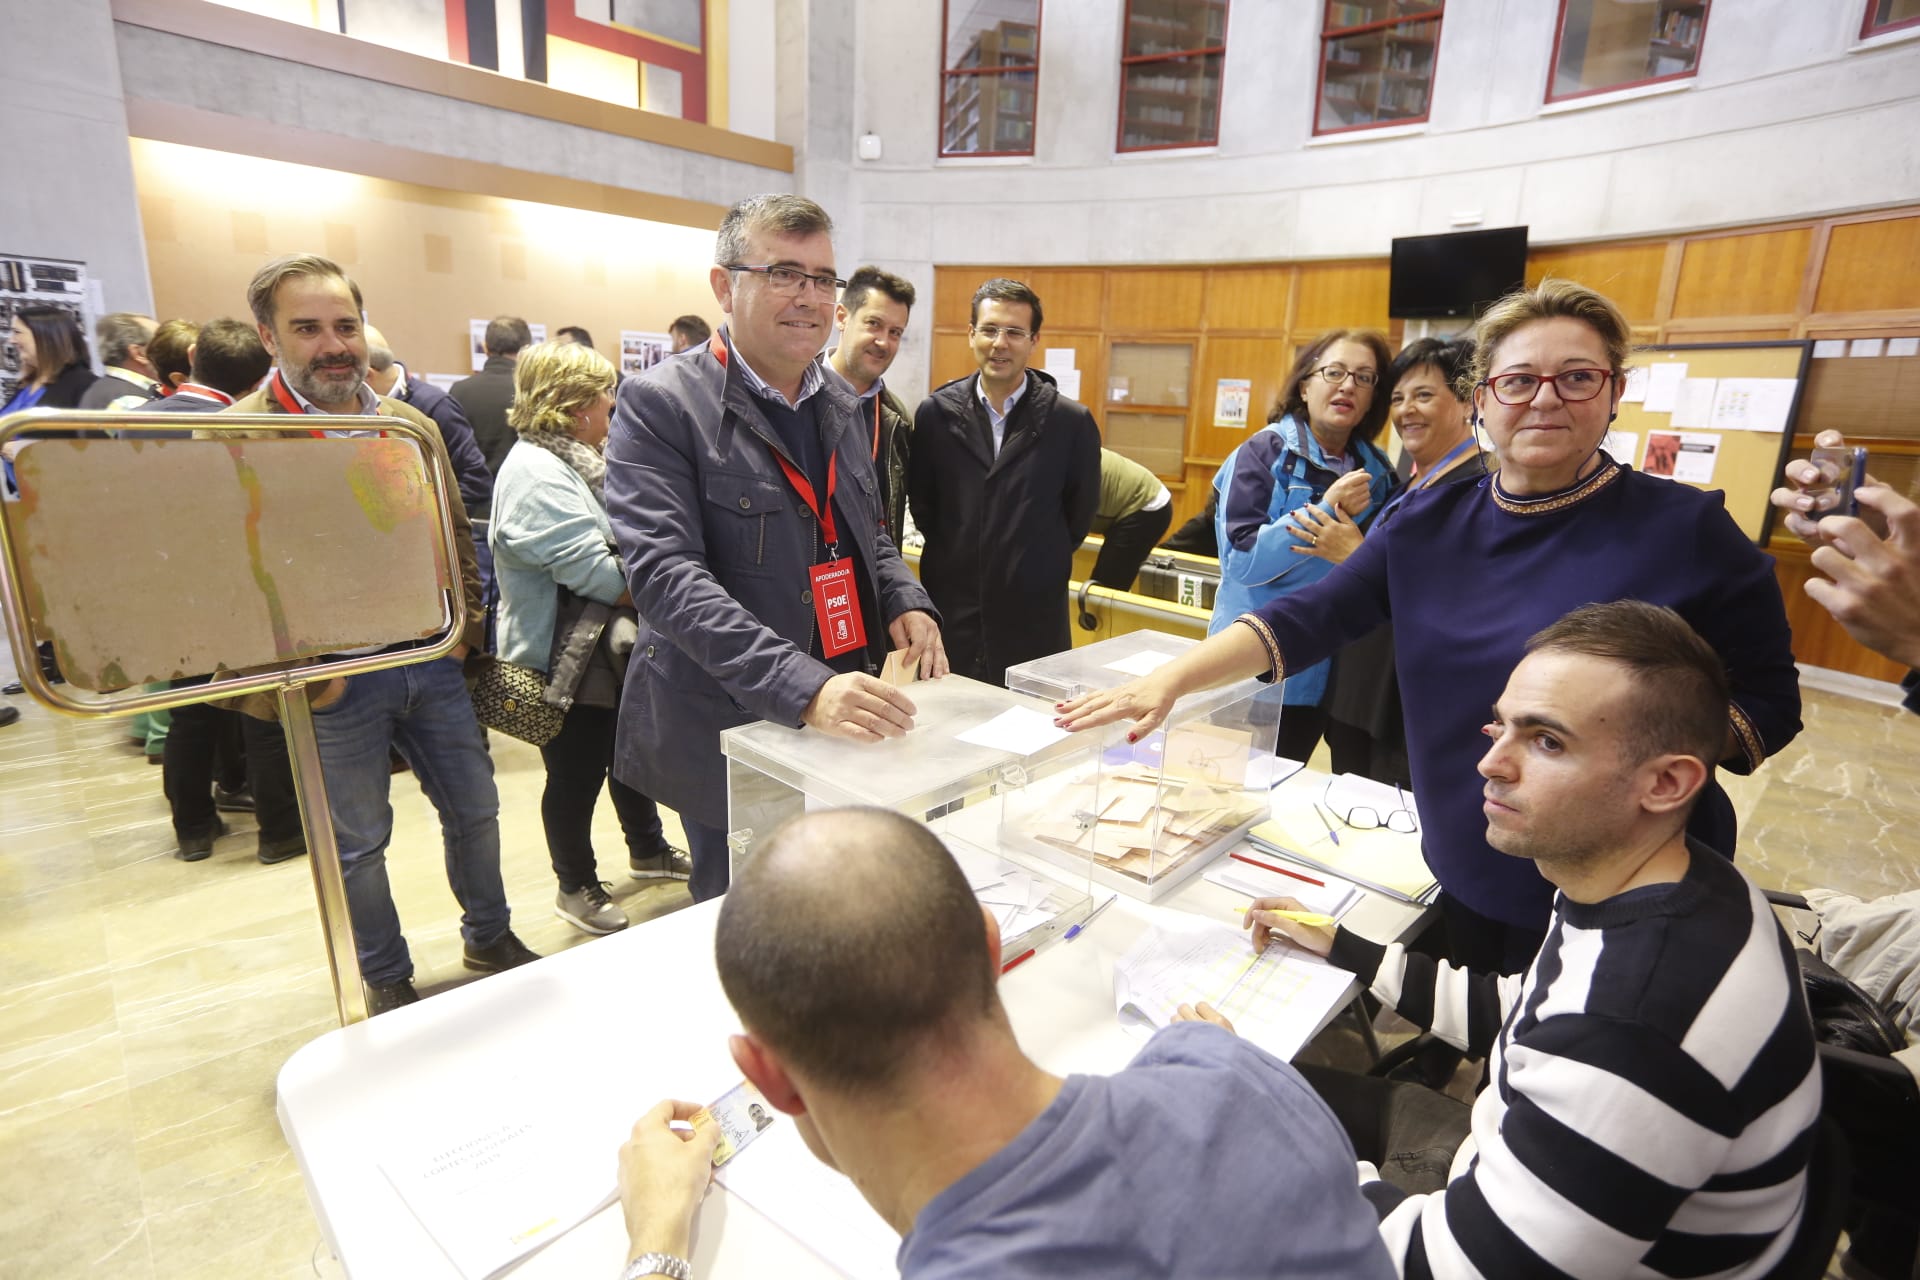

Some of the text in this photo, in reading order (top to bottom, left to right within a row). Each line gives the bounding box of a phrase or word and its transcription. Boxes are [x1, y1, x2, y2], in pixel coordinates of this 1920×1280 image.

[815, 568, 850, 582] APODERADO/A
[1181, 576, 1194, 607] Sur
[827, 594, 847, 608] PSOE
